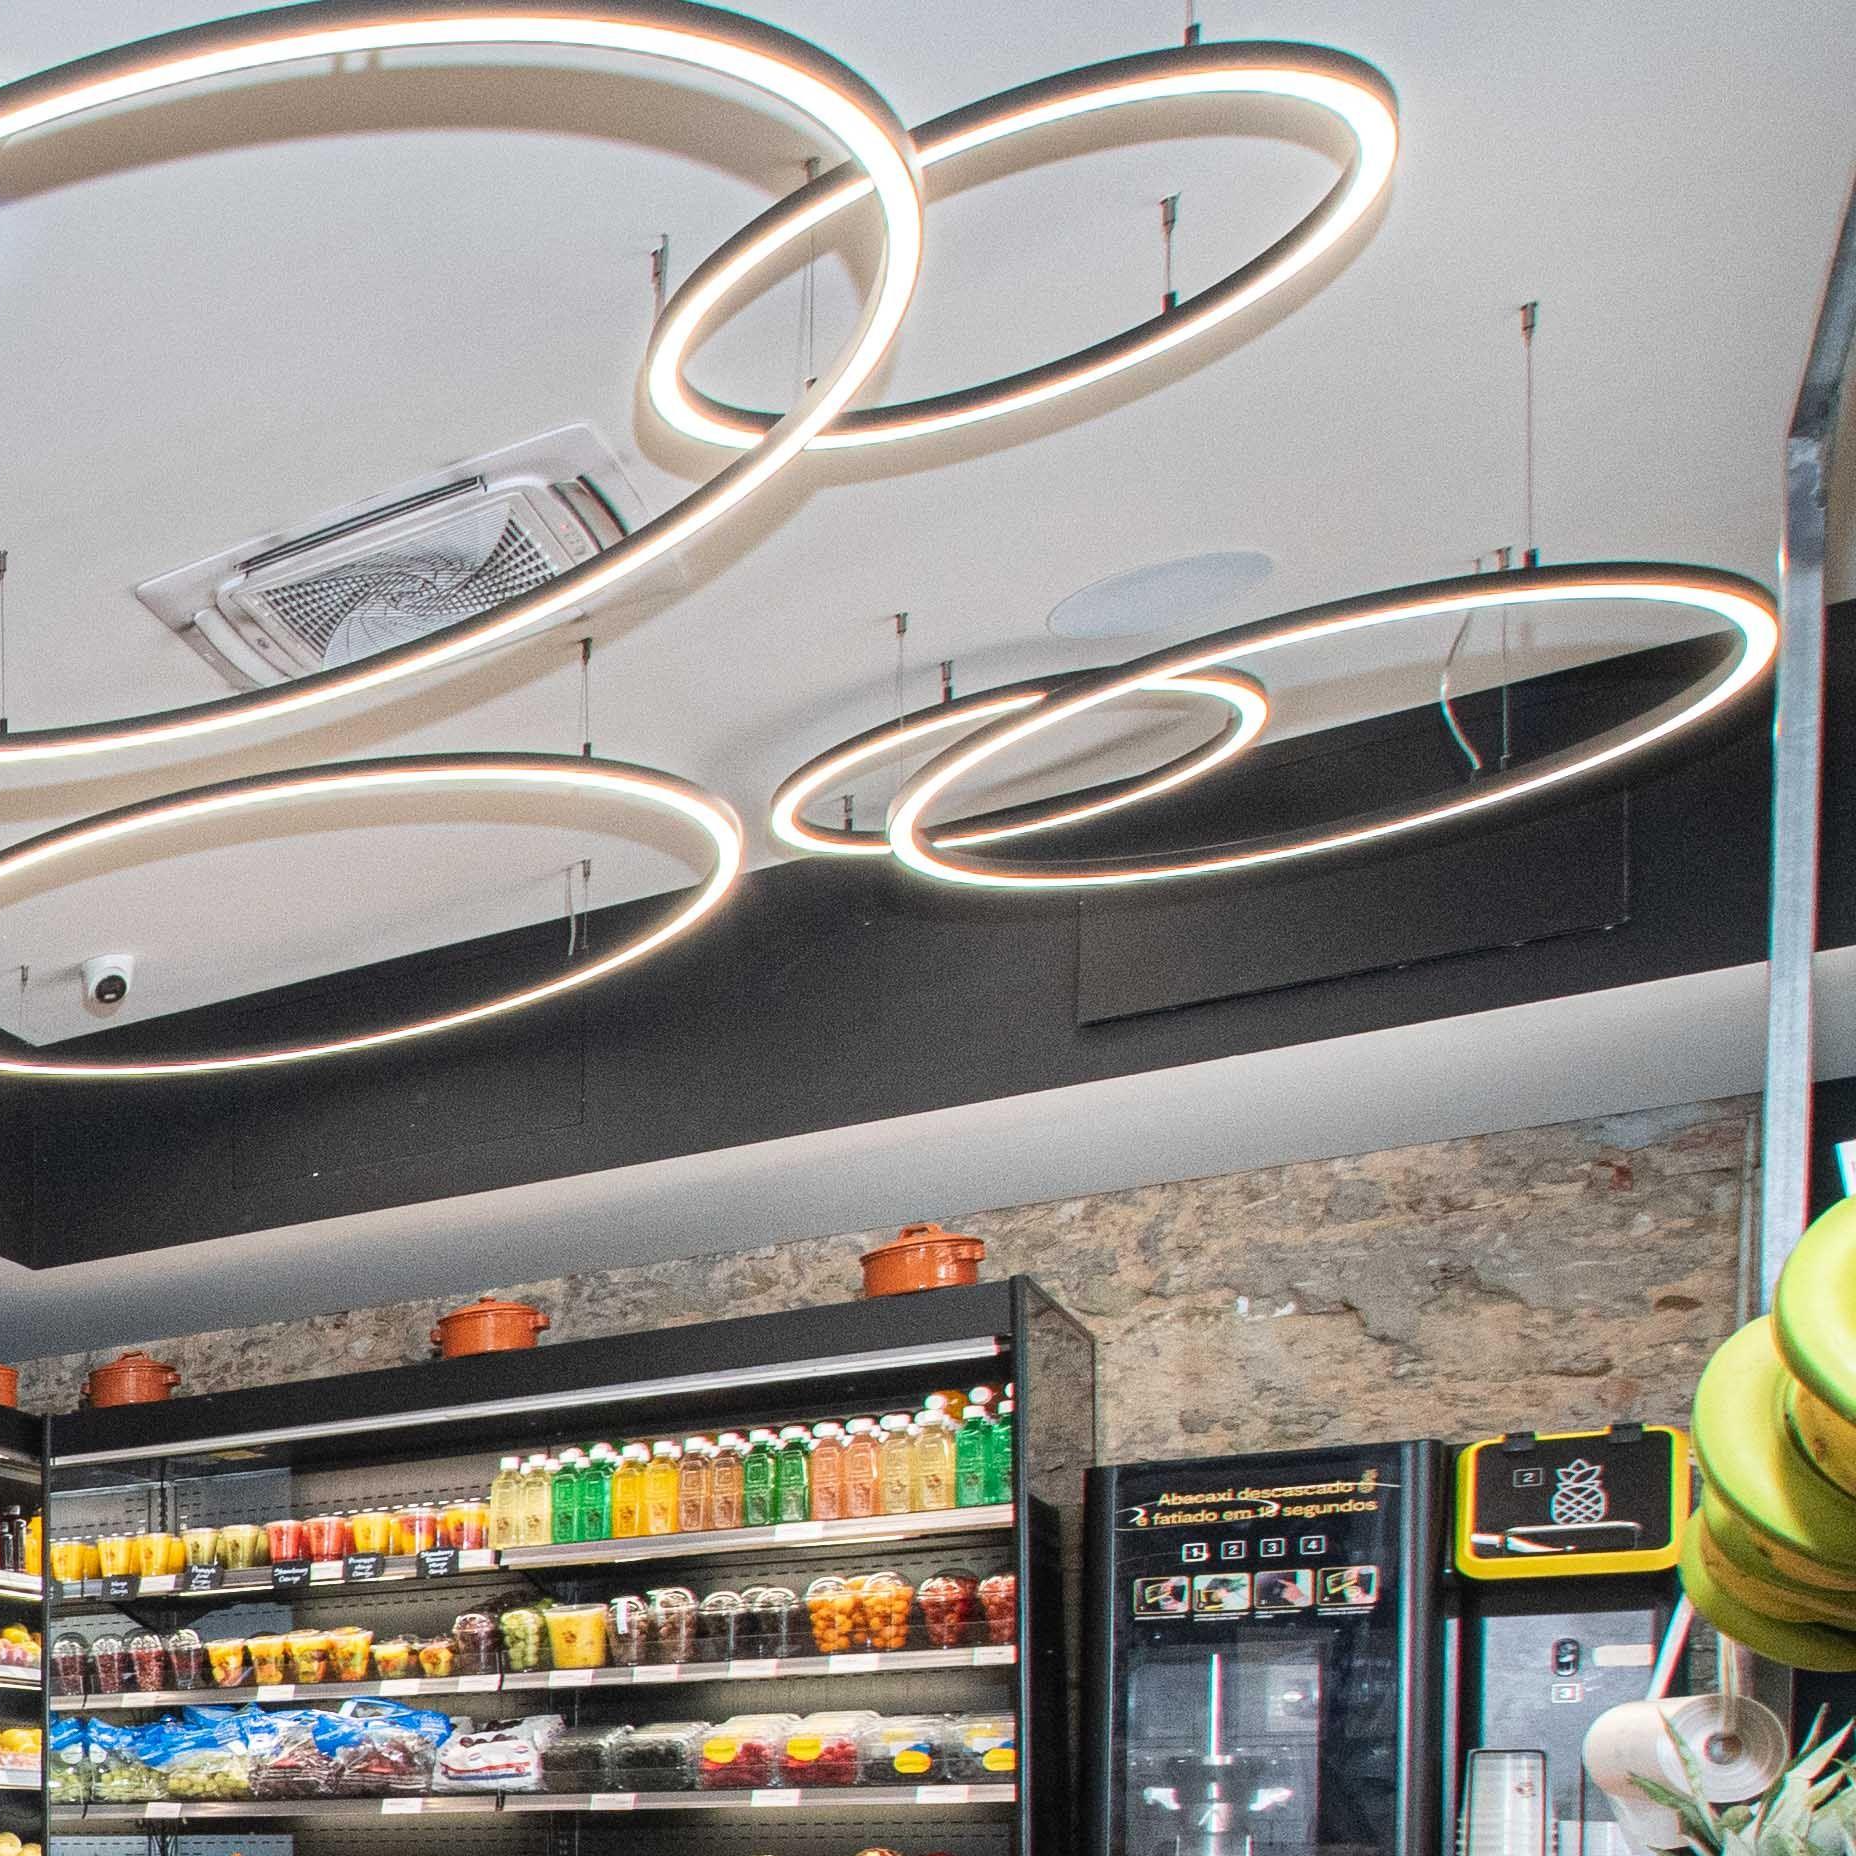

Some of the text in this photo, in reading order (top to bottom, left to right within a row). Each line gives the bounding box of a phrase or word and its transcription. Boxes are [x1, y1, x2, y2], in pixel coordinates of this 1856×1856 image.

[1157, 1480, 1355, 1507] Abacaxi descascado
[1153, 1508, 1219, 1526] fatiado
[1222, 1508, 1252, 1521] em
[1282, 1498, 1378, 1518] segundos
